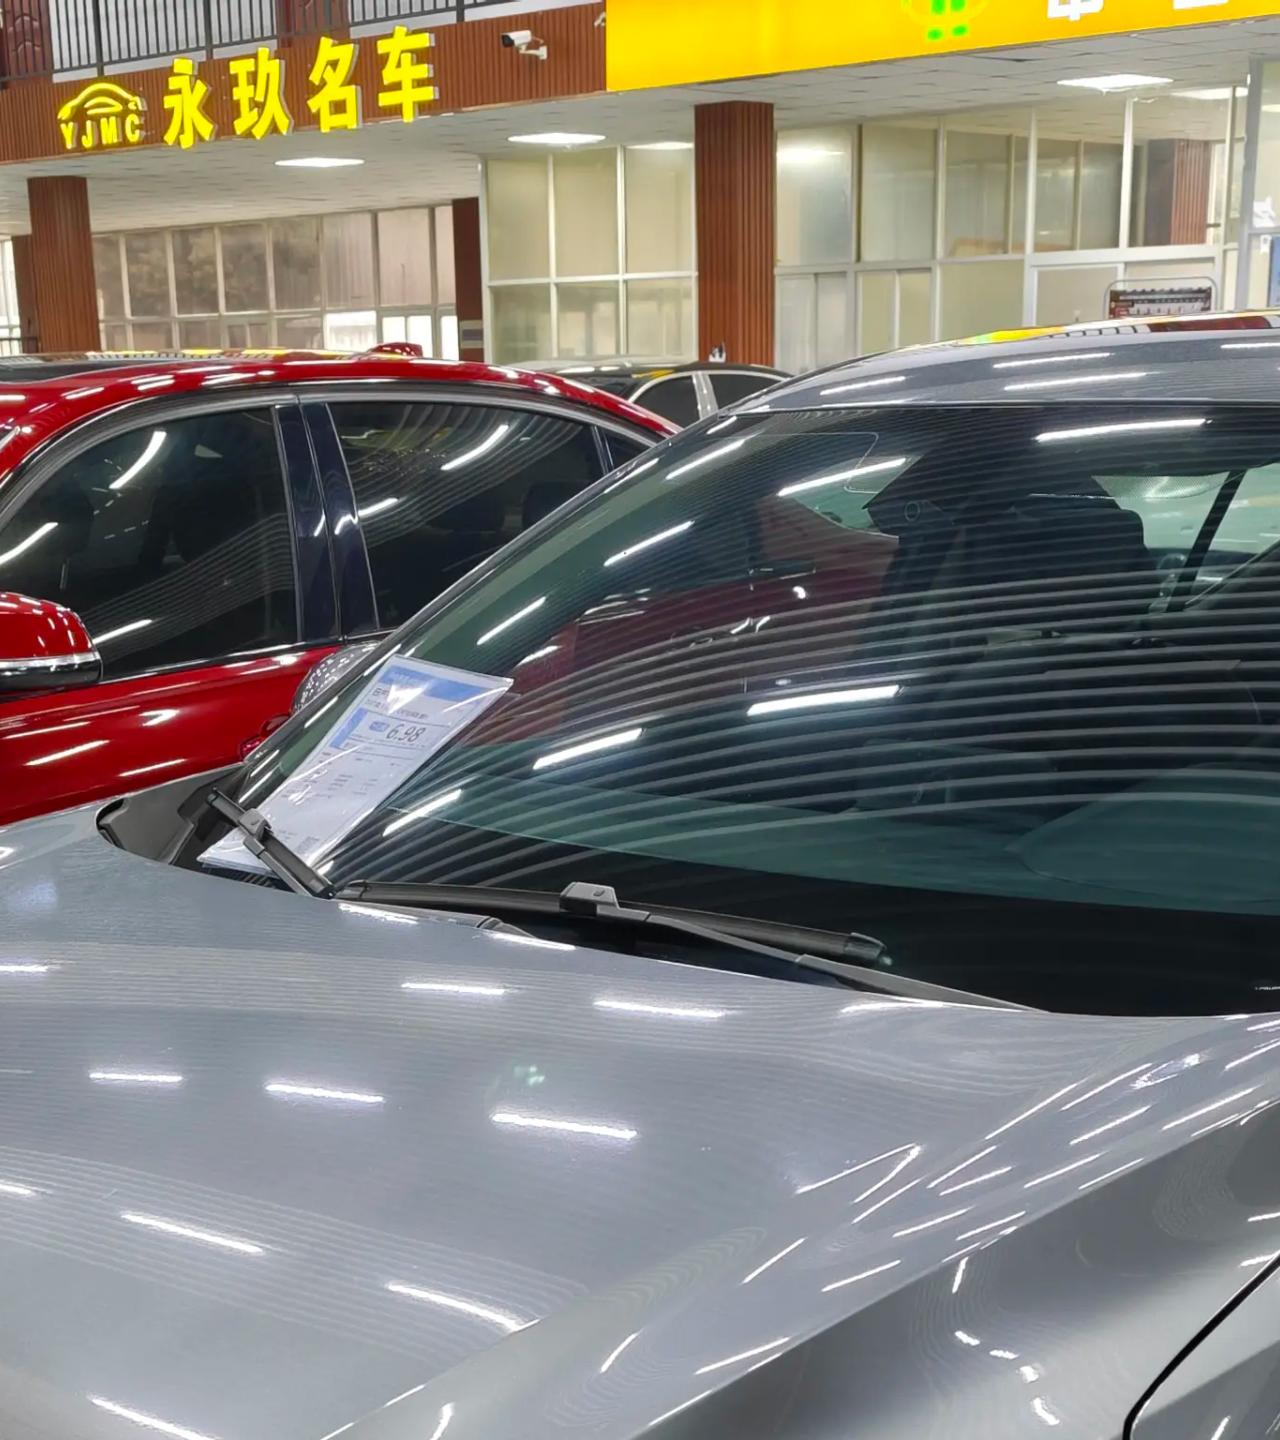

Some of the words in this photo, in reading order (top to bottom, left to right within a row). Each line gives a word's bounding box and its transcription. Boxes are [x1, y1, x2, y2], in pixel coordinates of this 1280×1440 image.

[163, 25, 437, 150] 永玖名车
[60, 118, 143, 149] YJMC
[386, 723, 426, 743] 6.98
